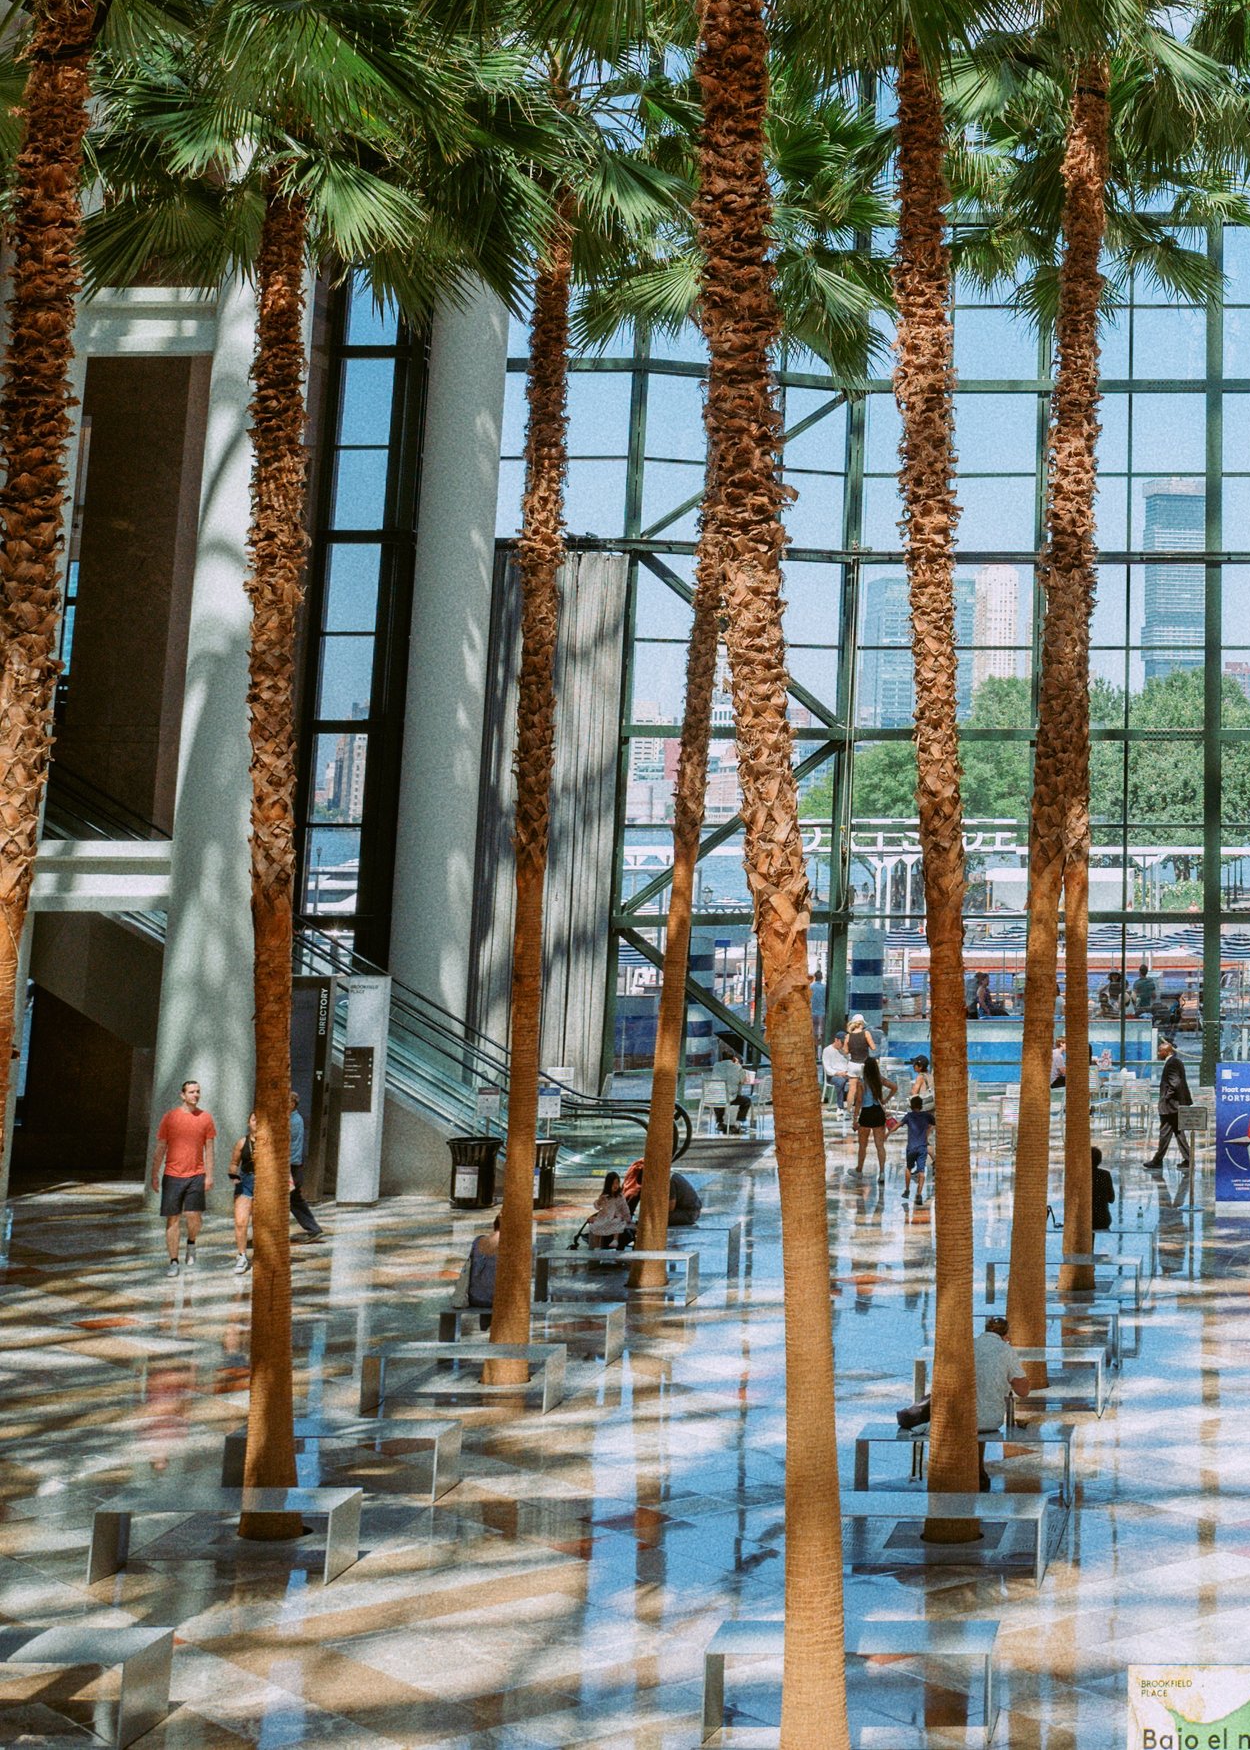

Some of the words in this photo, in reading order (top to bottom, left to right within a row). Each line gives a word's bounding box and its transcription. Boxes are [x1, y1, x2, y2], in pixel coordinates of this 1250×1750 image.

[318, 988, 329, 1035] DIRECTORY
[1141, 1679, 1193, 1688] BROOKFIELD
[1141, 1689, 1168, 1697] PLACE
[1143, 1727, 1199, 1750] Bajo
[1208, 1728, 1228, 1750] el
